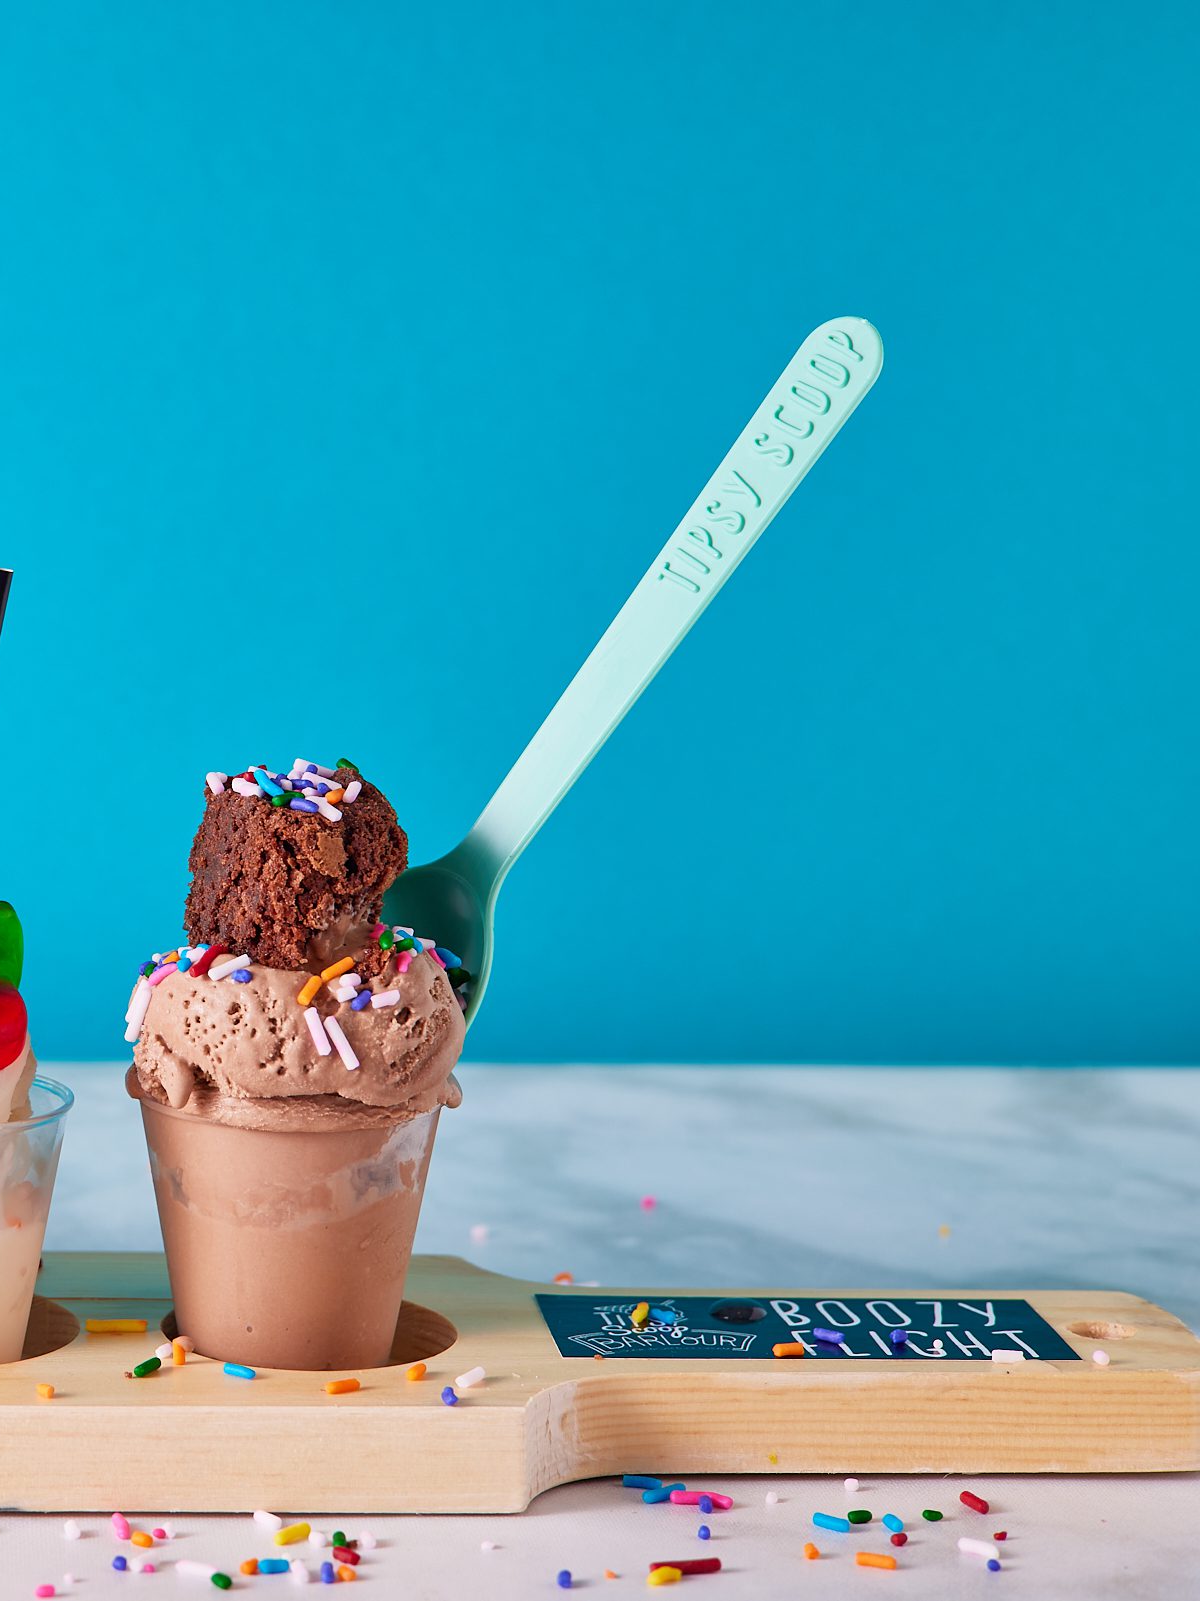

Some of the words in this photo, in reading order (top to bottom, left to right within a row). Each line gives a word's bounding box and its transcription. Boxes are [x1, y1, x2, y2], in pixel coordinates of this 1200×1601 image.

[657, 470, 762, 594] TIPSY
[754, 330, 864, 467] SCOOP
[769, 1300, 996, 1327] BOOZY
[587, 1333, 737, 1350] BARLOUR
[601, 1324, 689, 1339] Scoop
[791, 1330, 1040, 1358] FLIGHT
